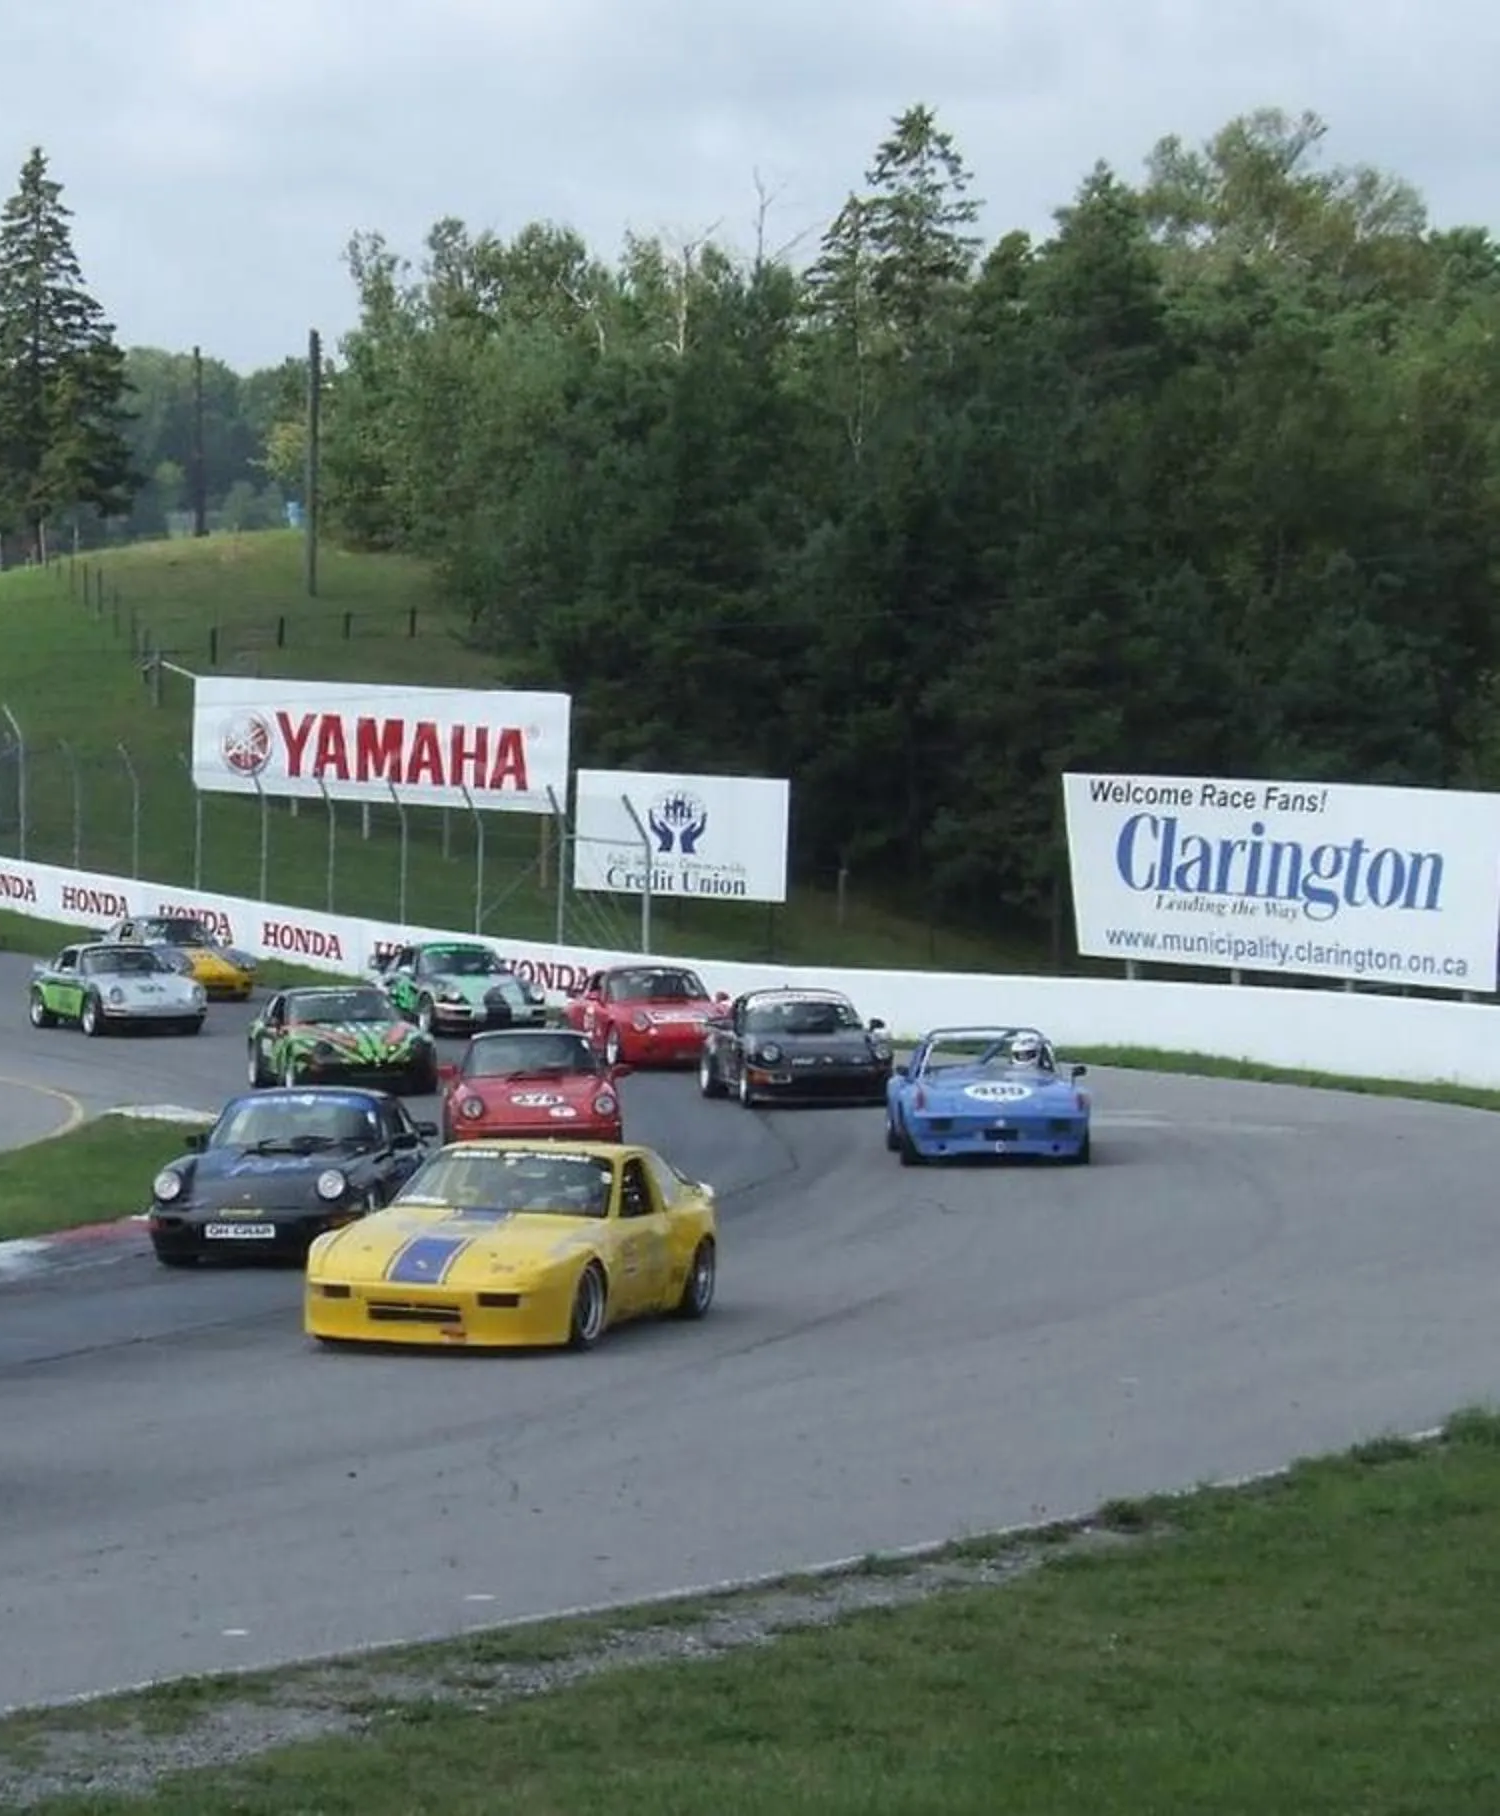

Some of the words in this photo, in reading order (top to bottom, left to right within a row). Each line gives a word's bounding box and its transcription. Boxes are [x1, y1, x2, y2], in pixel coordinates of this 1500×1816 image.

[275, 711, 528, 791] YAMAHA
[1090, 780, 1193, 806] Welcome
[1200, 783, 1256, 809] Race
[1263, 786, 1328, 813] Fans!
[606, 866, 677, 891] Credit
[682, 872, 747, 896] Union
[1116, 813, 1443, 921] Clarington
[62, 885, 129, 919] HONDA
[1231, 900, 1260, 917] the
[1264, 901, 1299, 924] Way
[262, 922, 344, 961] HONDA
[1106, 925, 1468, 977] www.municipality.clarington.on.ca
